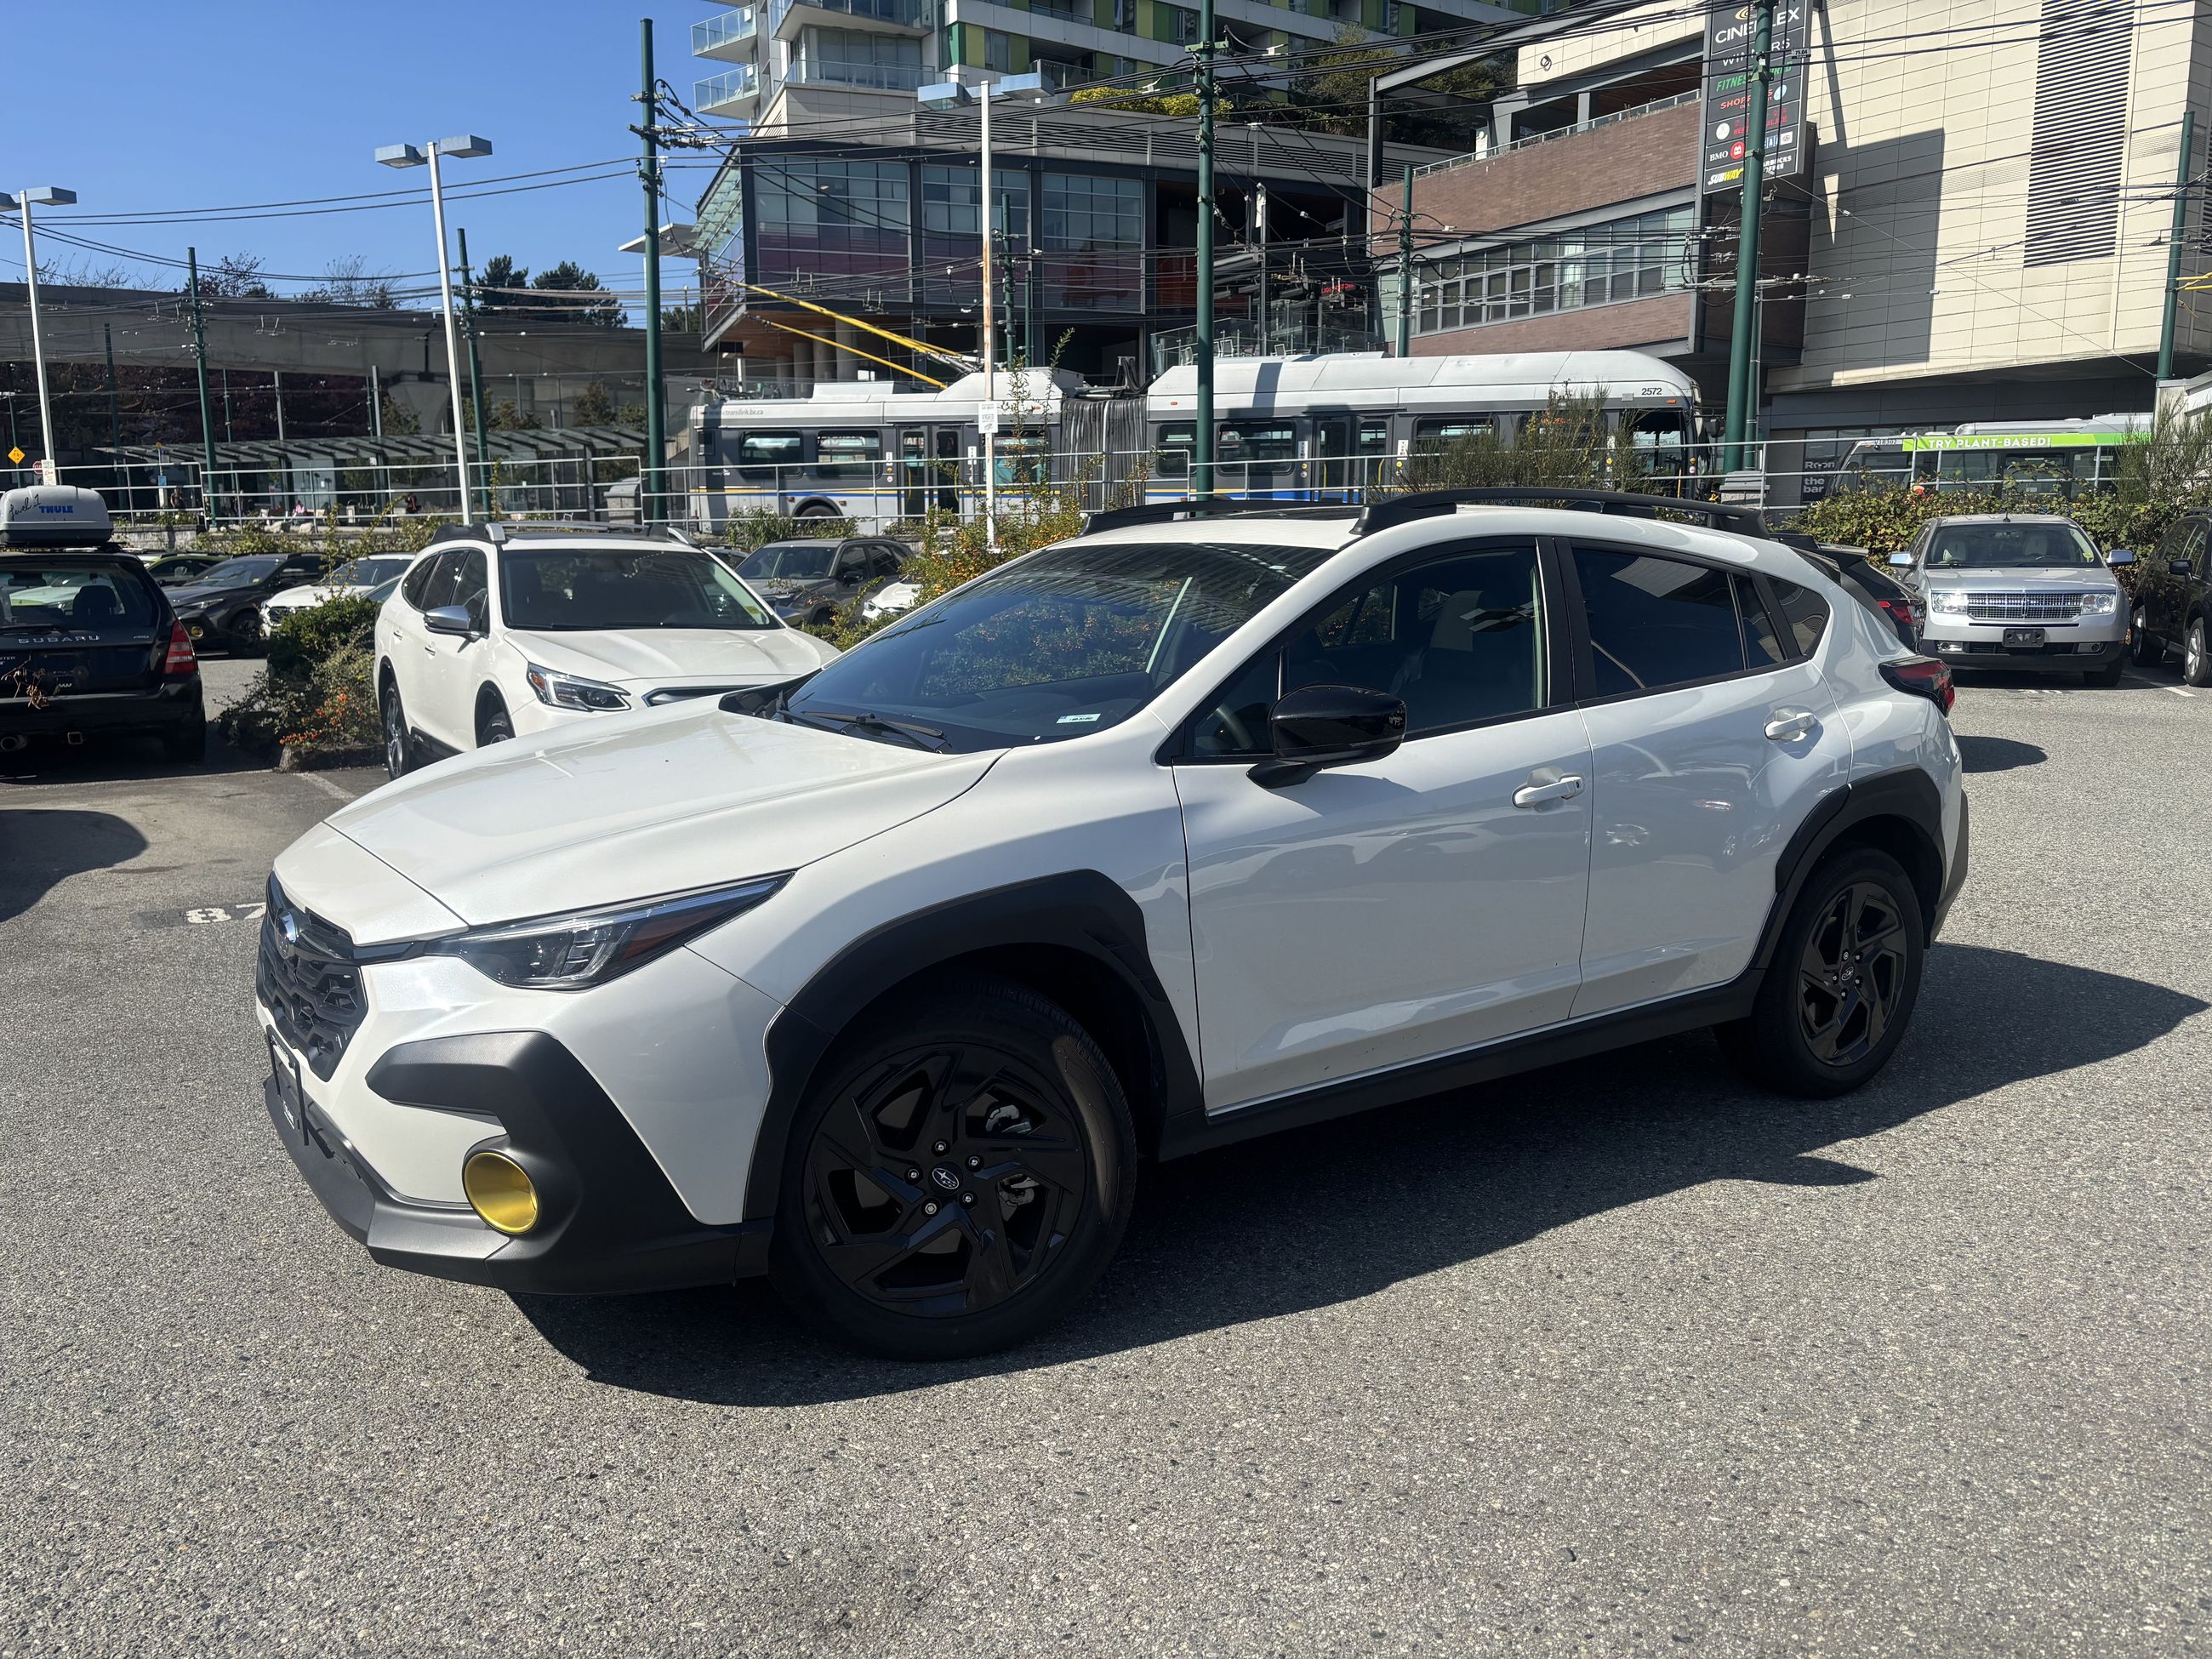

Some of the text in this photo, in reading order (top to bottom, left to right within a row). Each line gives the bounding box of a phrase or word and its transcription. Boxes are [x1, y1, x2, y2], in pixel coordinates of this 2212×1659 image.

[1715, 7, 1800, 43] CINEEX
[1723, 38, 1790, 66] WINRS
[1709, 150, 1729, 162] BMO
[1707, 167, 1744, 185] SUBWAY
[1641, 387, 1662, 396] 2572
[1929, 437, 2051, 449] TRY PLANT-BASED!
[40, 505, 74, 514] THULE
[18, 635, 100, 644] SUBARU
